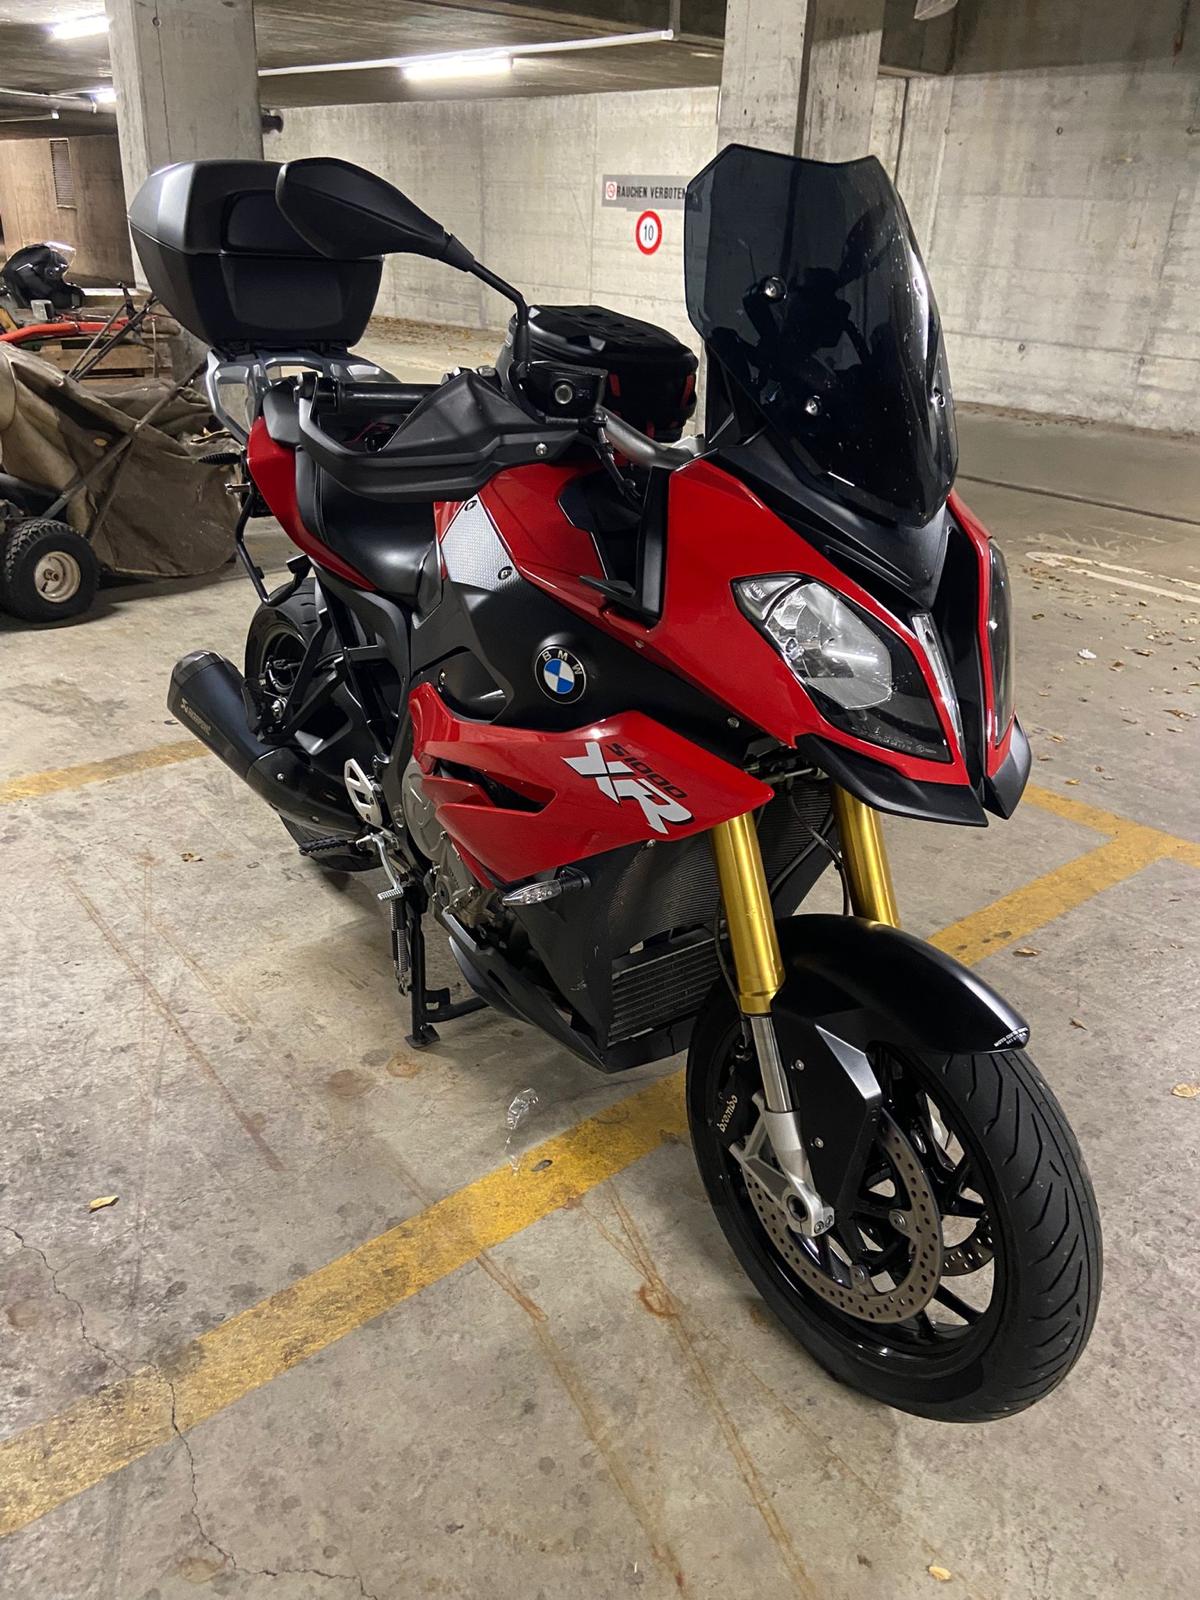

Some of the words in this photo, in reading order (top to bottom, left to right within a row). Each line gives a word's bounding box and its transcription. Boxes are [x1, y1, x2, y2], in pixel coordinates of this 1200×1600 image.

[616, 186, 648, 198] RAUCHEN
[643, 224, 655, 241] 10
[560, 741, 695, 835] XR
[716, 1095, 738, 1132] brembo
